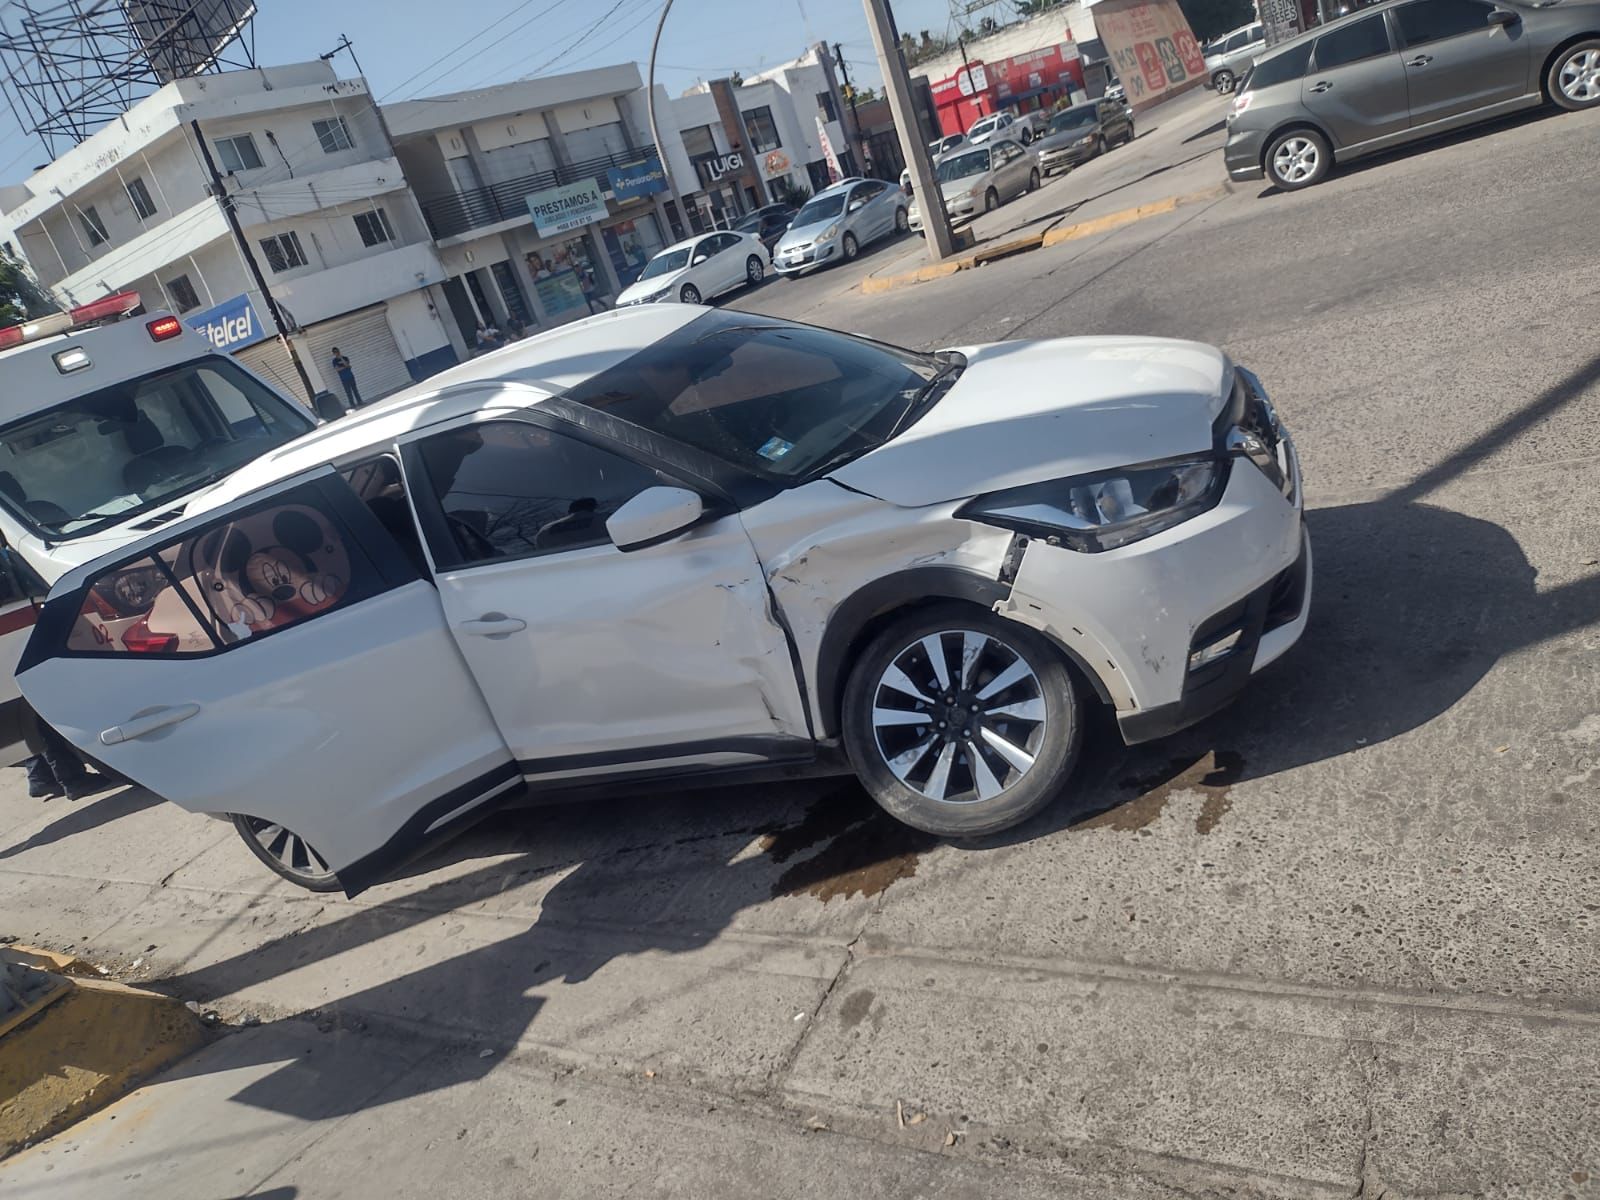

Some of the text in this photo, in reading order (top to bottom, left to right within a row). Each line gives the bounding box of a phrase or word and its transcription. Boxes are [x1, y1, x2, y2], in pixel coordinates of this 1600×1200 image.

[706, 153, 744, 181] LUIGI
[591, 189, 599, 201] A
[207, 306, 253, 348] telcel
[92, 623, 114, 645] 02
